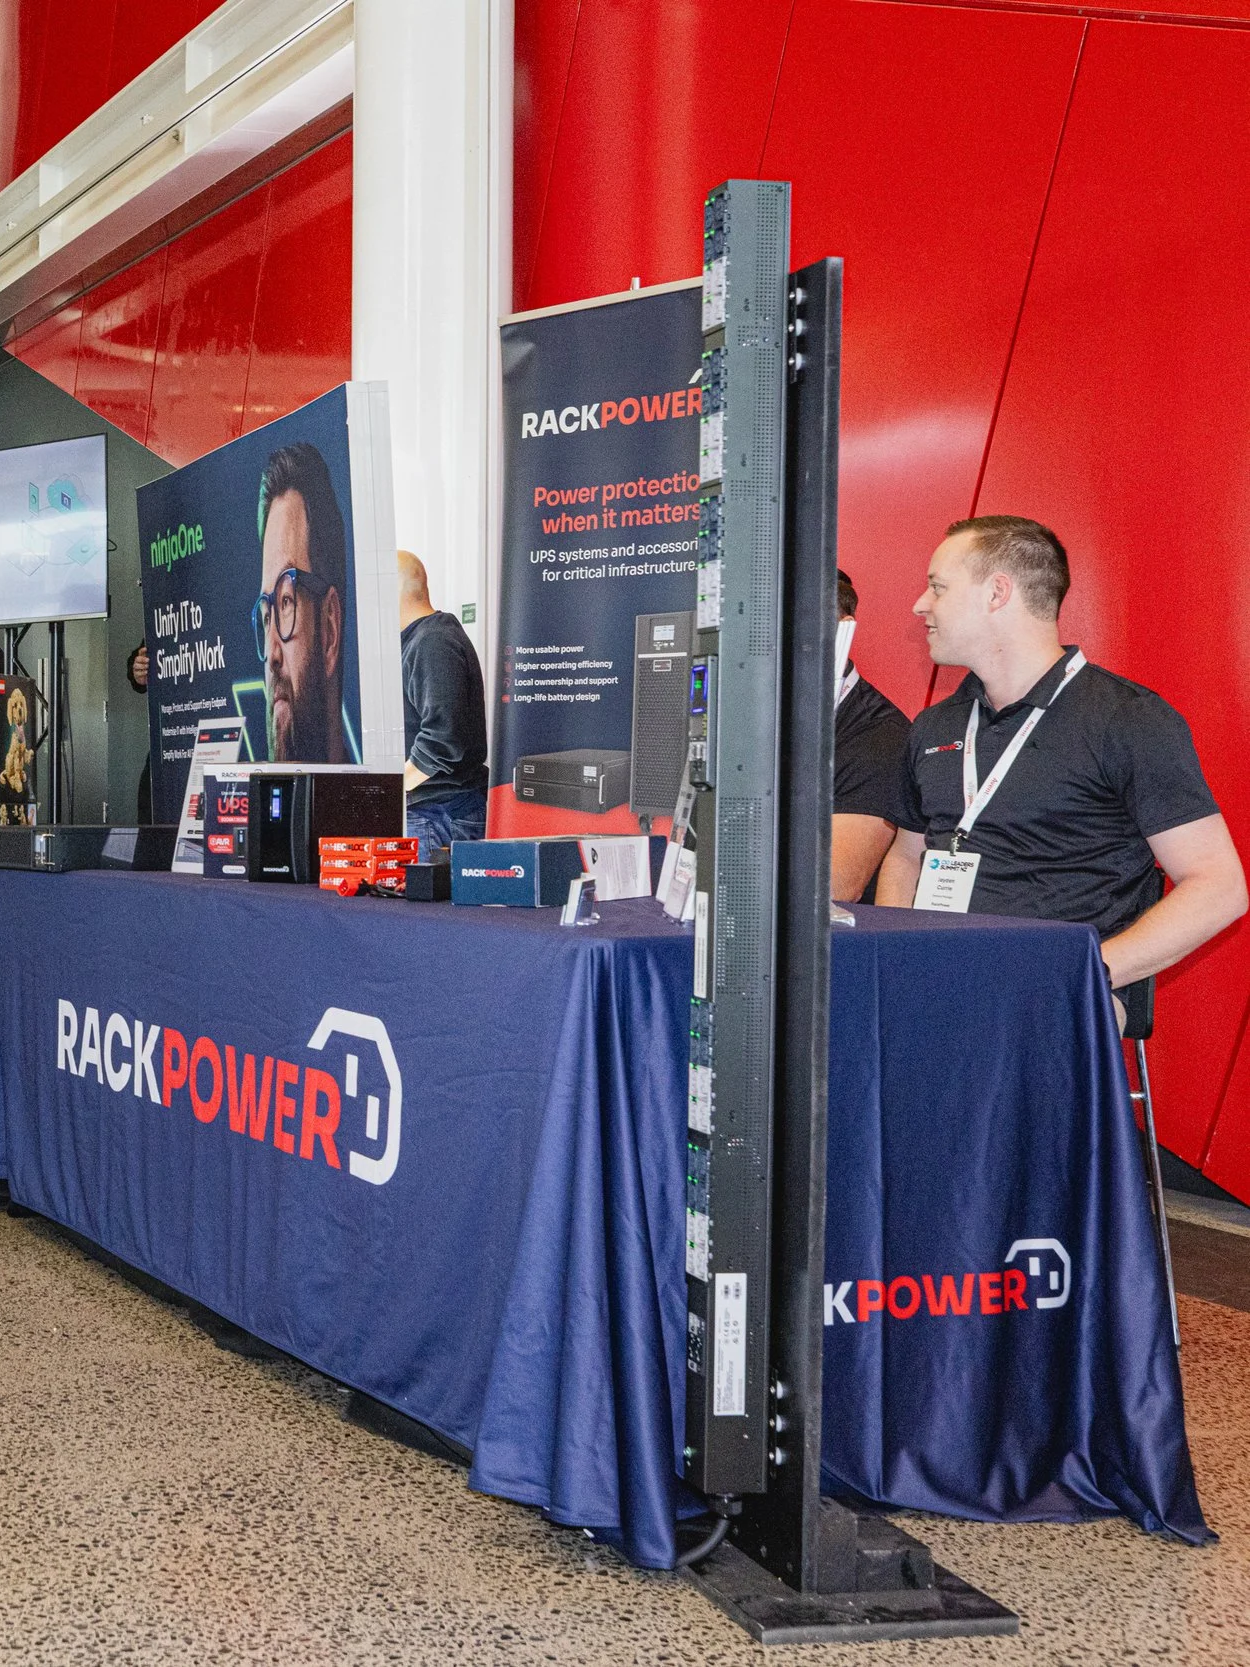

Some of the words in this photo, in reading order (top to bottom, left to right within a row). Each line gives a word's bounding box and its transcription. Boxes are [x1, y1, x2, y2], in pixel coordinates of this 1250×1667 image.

[521, 386, 702, 439] RACKPOWER
[533, 486, 599, 508] Power
[602, 470, 700, 506] protectio
[542, 512, 599, 534] when
[602, 507, 617, 529] it
[621, 502, 700, 528] matters
[150, 523, 204, 573] ninjaOne
[530, 549, 557, 563] UPS
[558, 548, 609, 565] systems
[611, 543, 635, 558] and
[637, 537, 698, 556] accessori
[542, 568, 561, 582] for
[563, 564, 606, 580] critical
[608, 560, 698, 577] infrastructure.
[154, 603, 179, 643] Unify
[180, 600, 189, 632] IT
[190, 601, 203, 630] to
[156, 642, 195, 685] Simplify
[195, 636, 226, 672] Work
[515, 646, 534, 655] More
[535, 645, 560, 654] usable
[560, 645, 585, 655] power
[515, 662, 539, 672] Higher
[540, 661, 577, 671] operating
[577, 659, 613, 670] efficiency
[514, 678, 534, 686] Local
[535, 677, 574, 687] ownership
[574, 677, 588, 685] and
[588, 676, 619, 686] support
[513, 694, 547, 704] Long-life
[548, 693, 575, 703] battery
[575, 693, 600, 703] design
[217, 797, 248, 814] UPS
[462, 868, 516, 878] RACKPOWER
[57, 998, 342, 1170] RACKPOWER
[823, 1269, 1028, 1326] KPOWER
